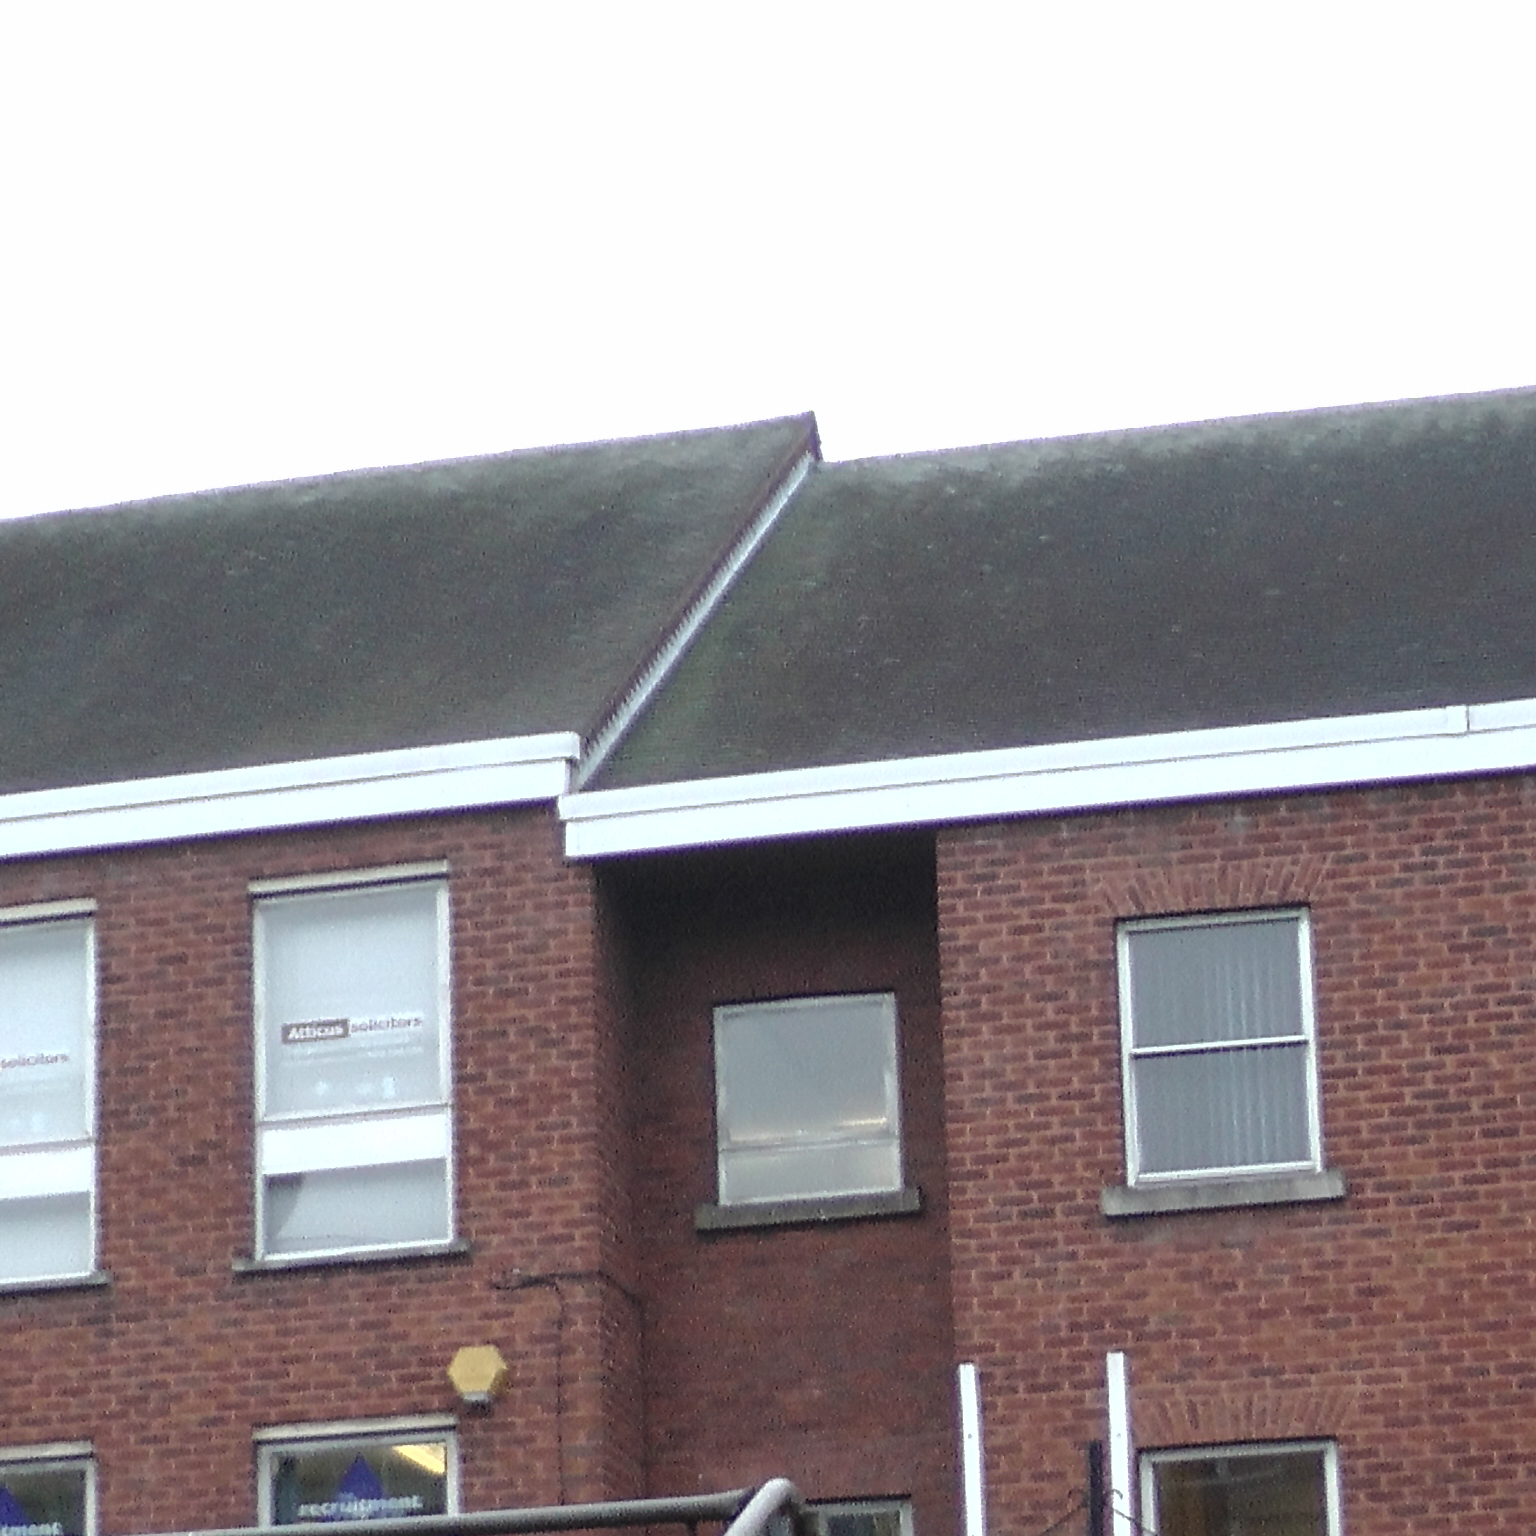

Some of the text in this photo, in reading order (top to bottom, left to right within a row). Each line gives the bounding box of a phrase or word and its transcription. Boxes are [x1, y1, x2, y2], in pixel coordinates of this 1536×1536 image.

[288, 1017, 423, 1041] Atticus solicitors
[1, 1053, 70, 1069] solicitors
[297, 1494, 424, 1518] recruitment
